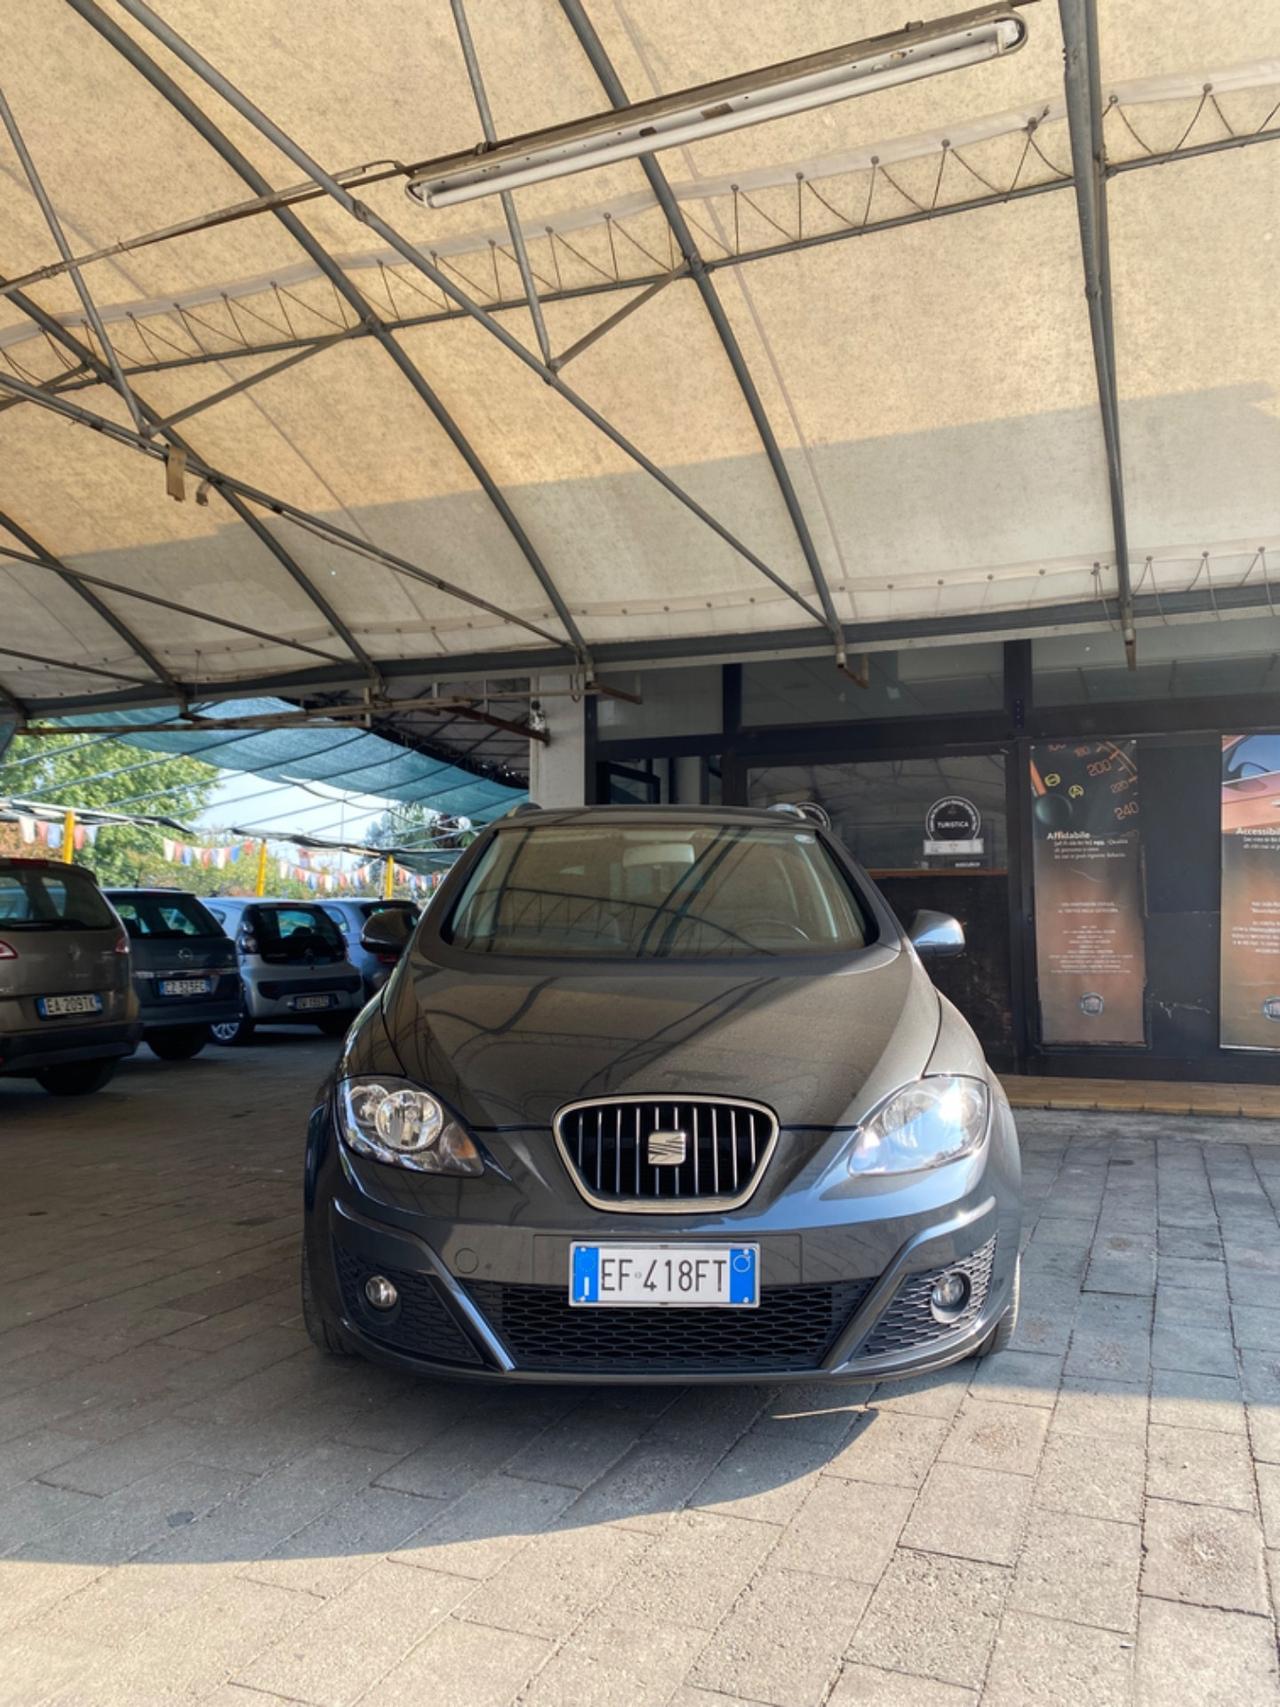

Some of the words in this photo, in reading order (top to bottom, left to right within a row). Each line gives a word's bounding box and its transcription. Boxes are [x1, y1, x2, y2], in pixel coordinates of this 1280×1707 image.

[1087, 759, 1112, 777] 200
[1113, 801, 1140, 820] 240
[937, 821, 969, 829] TURISTICA
[1046, 830, 1091, 840] Affidabile
[601, 1258, 634, 1292] EF
[643, 1259, 728, 1292] 418FT
